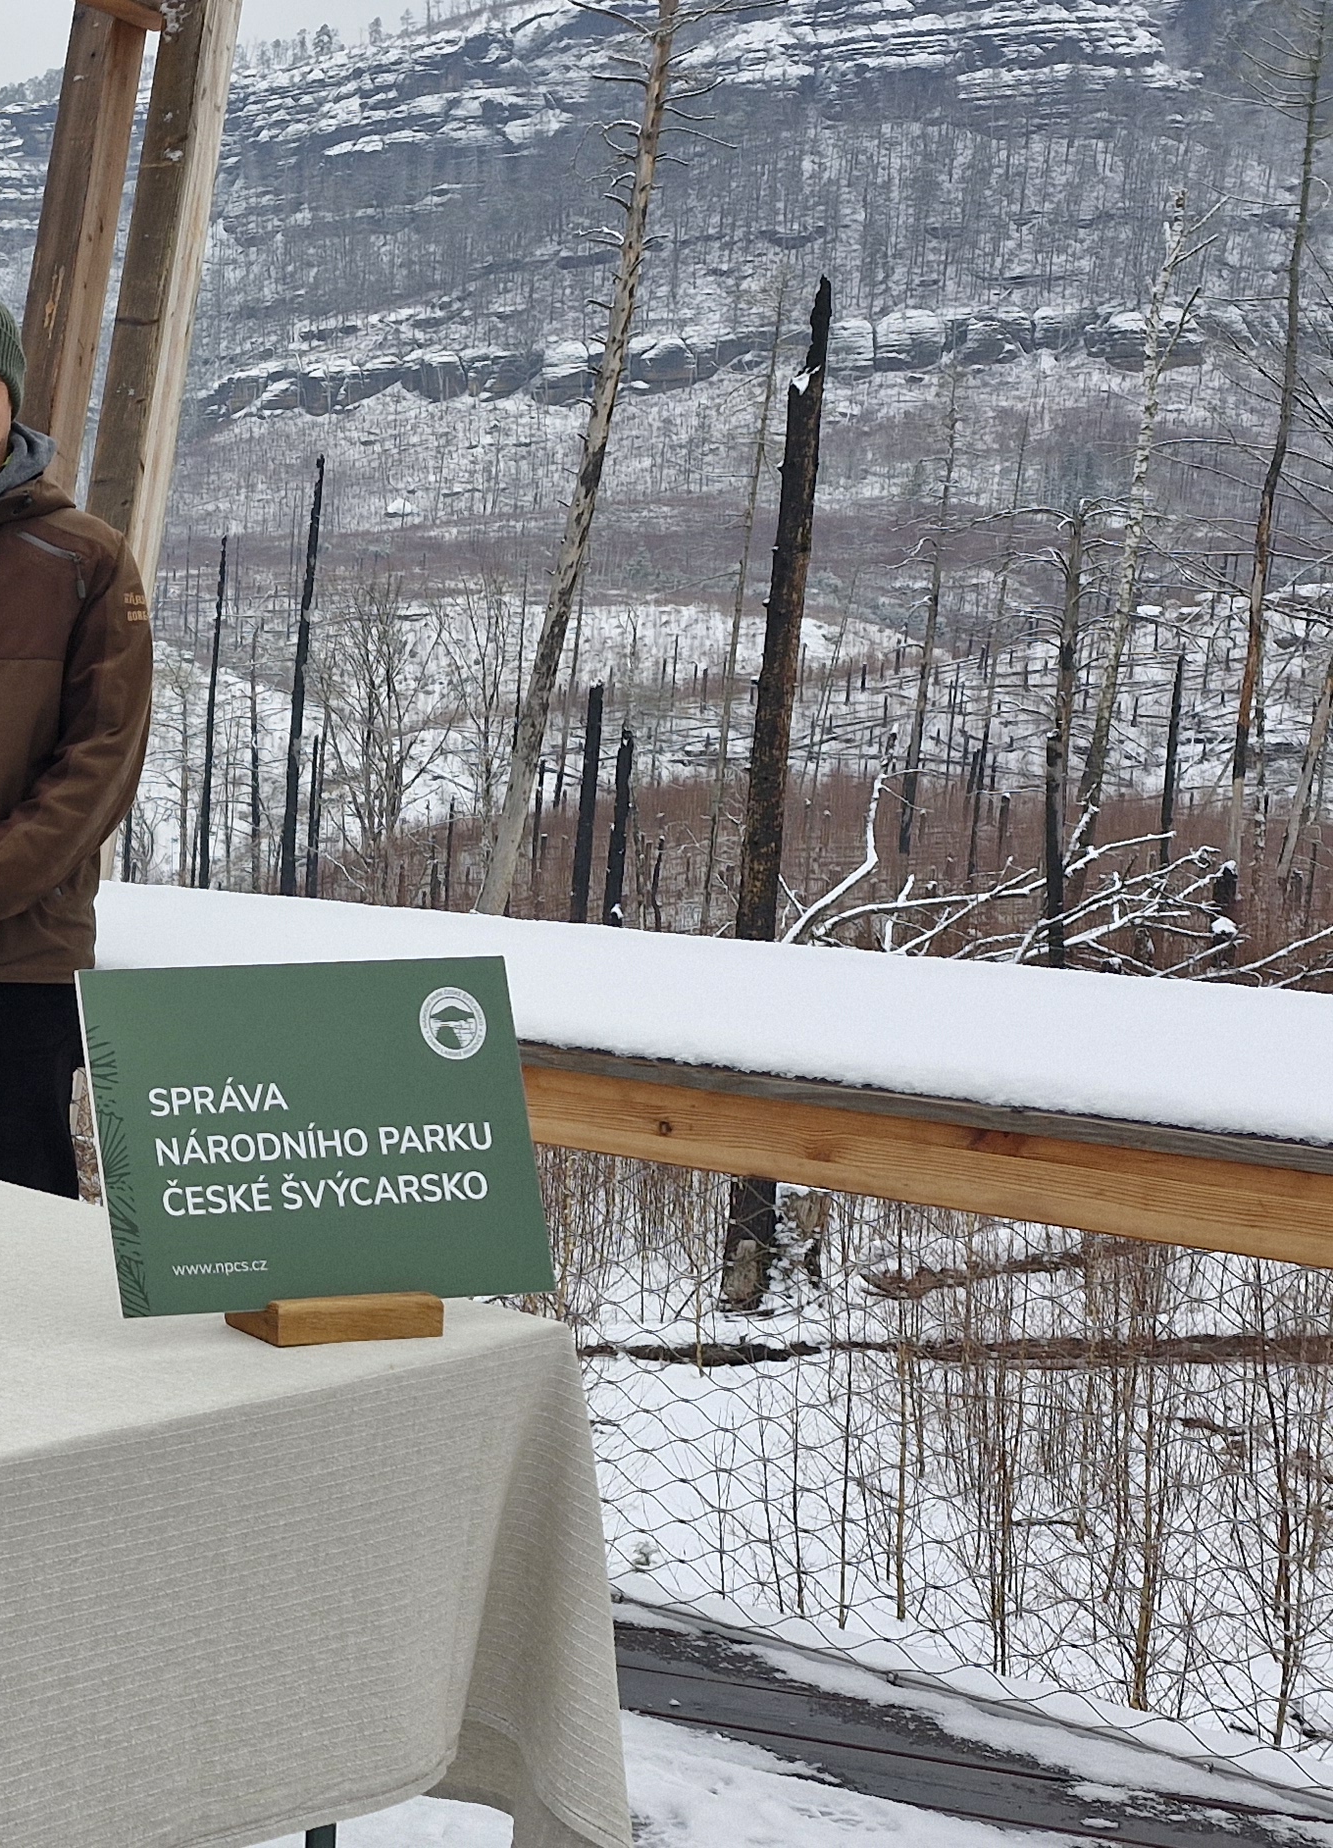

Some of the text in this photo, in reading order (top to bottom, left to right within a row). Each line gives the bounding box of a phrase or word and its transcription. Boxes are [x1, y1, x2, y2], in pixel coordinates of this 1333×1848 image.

[148, 1077, 289, 1117] SPRÁVA
[155, 1121, 493, 1167] NÁRODNÍHO PARKU
[162, 1170, 489, 1217] ČESKÉ ŠVÝCARSKO
[172, 1257, 269, 1277] www.npcs.cz
